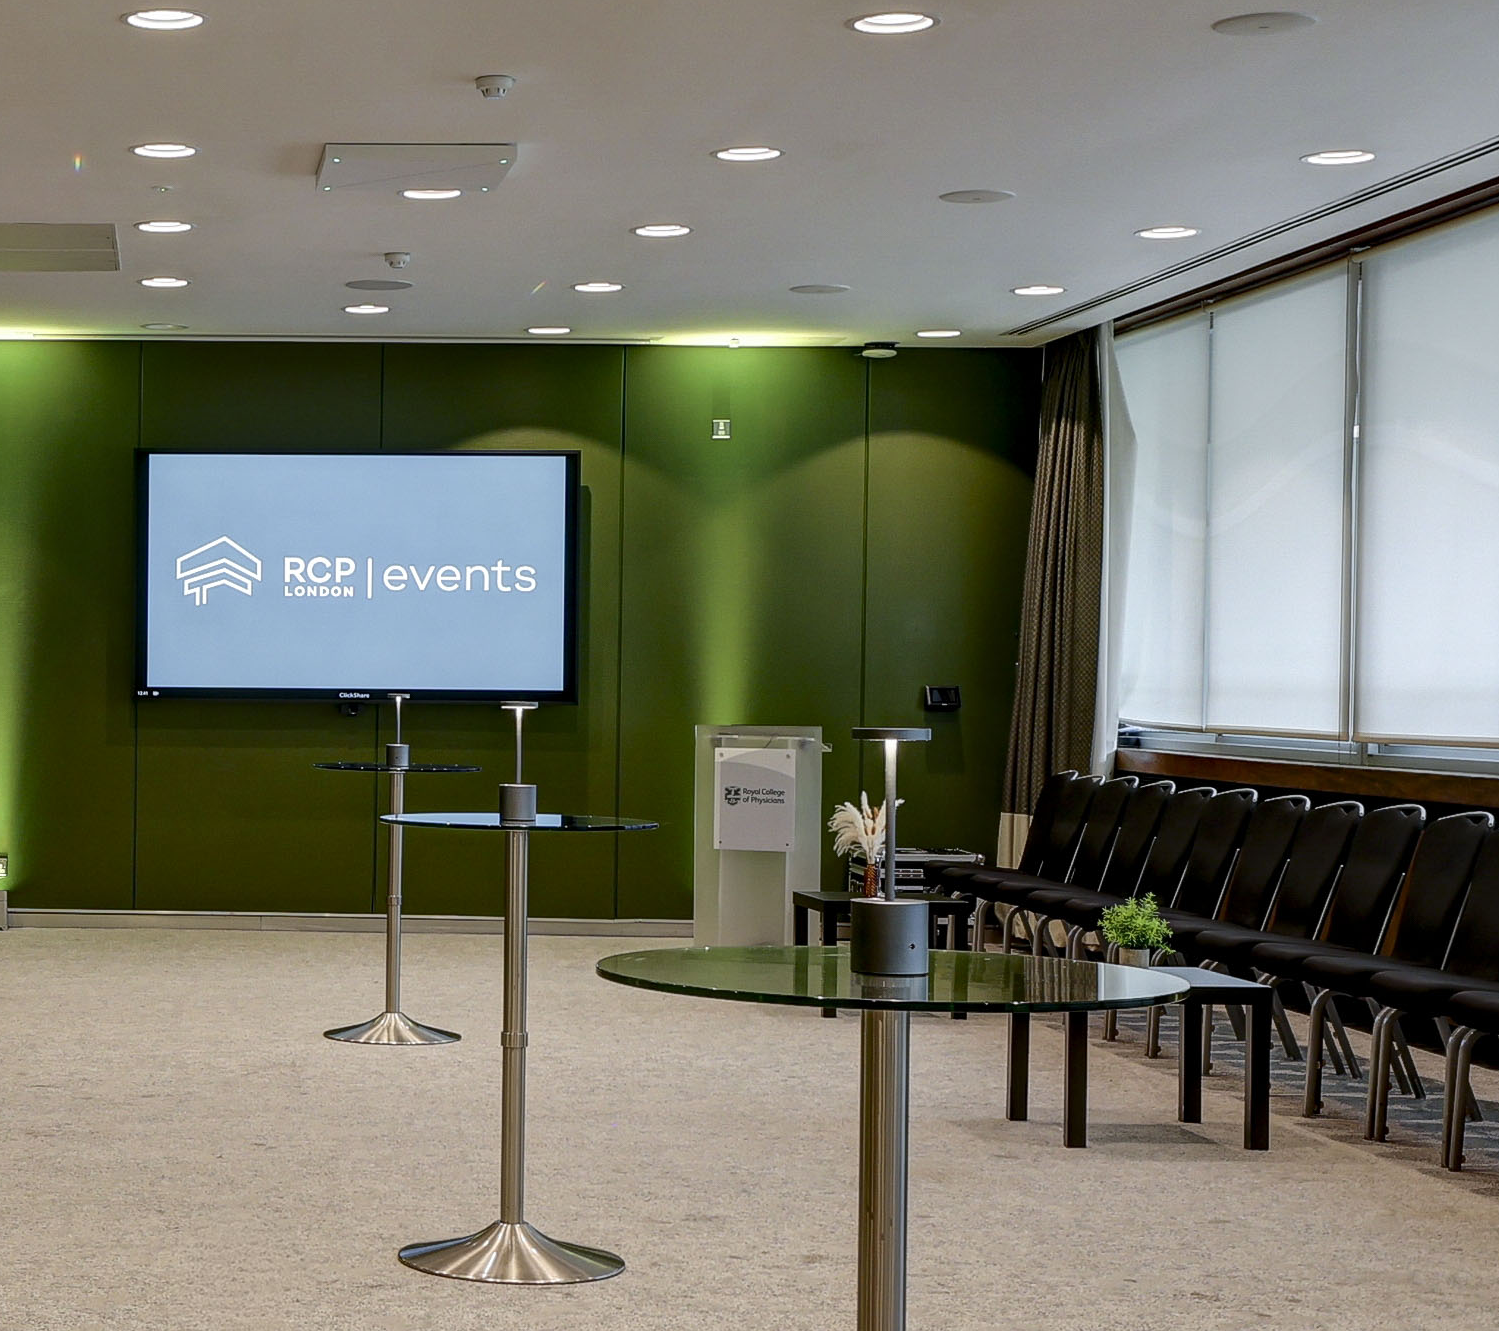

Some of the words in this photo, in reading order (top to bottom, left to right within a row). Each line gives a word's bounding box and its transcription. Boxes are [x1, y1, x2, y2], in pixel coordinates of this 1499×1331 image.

[284, 556, 356, 584] RCP
[383, 559, 537, 592] events
[284, 585, 354, 597] LONDON
[742, 788, 761, 796] Royal
[762, 788, 786, 797] College
[751, 796, 785, 805] Physicians
